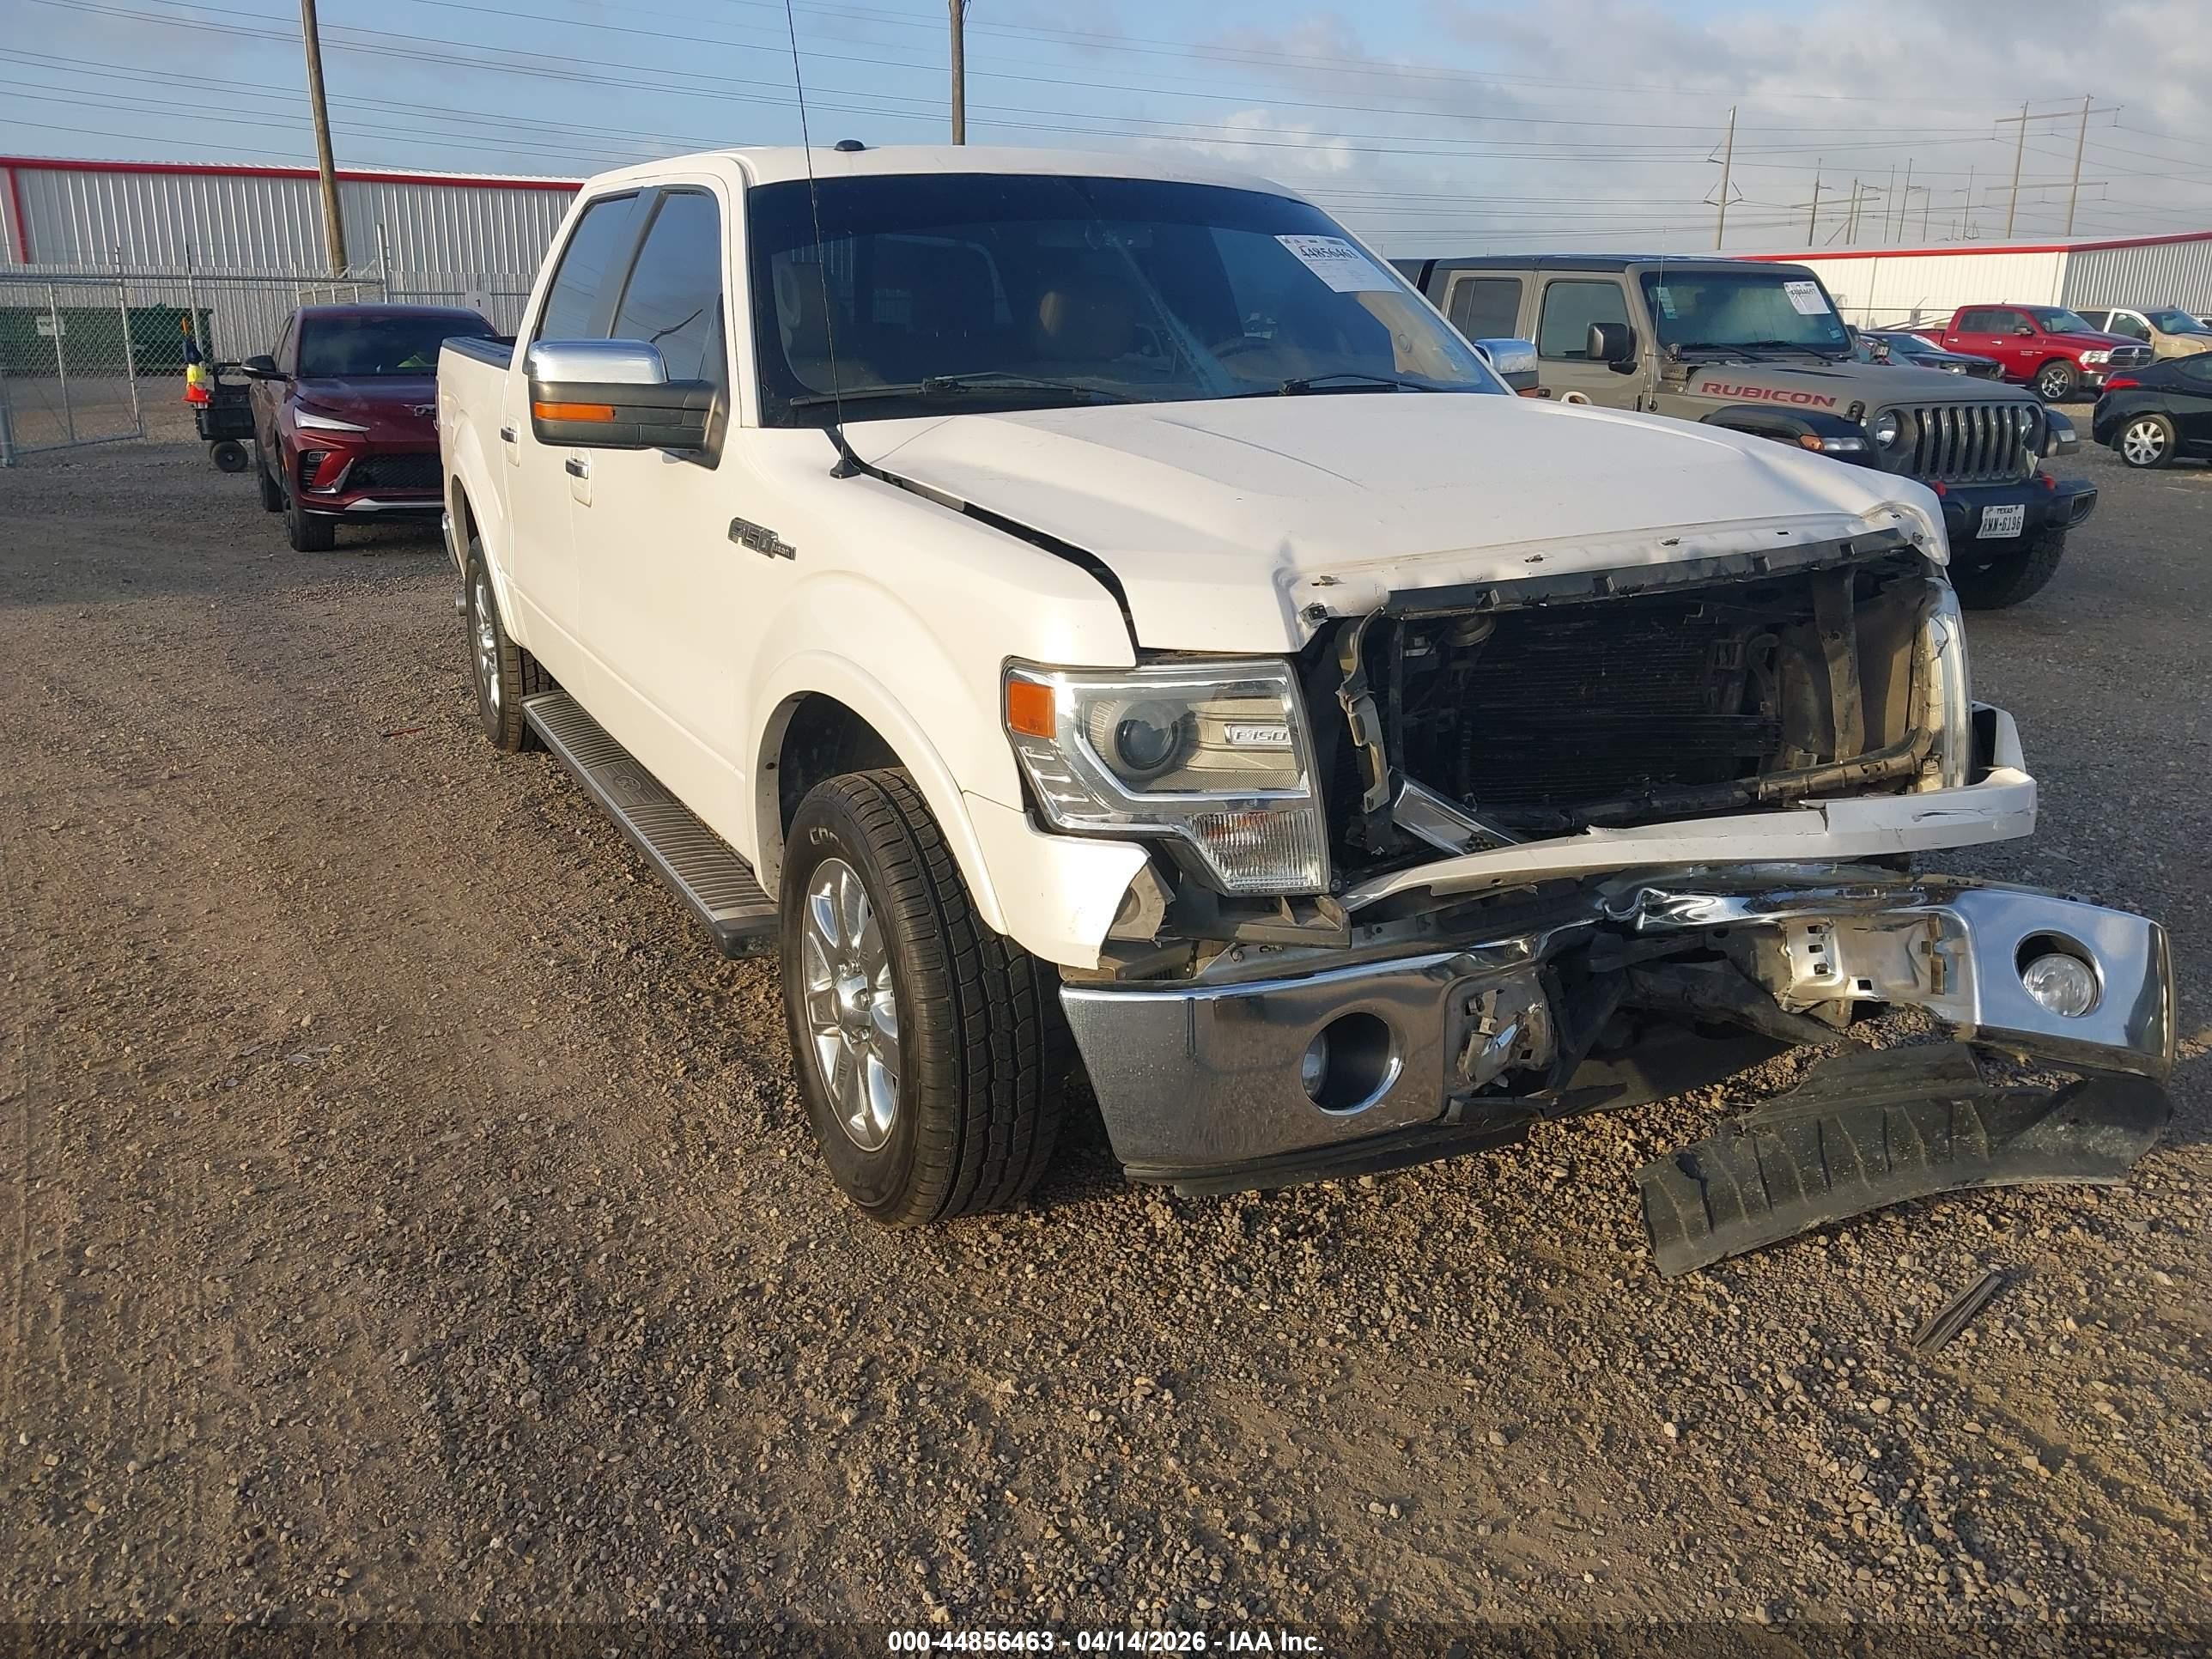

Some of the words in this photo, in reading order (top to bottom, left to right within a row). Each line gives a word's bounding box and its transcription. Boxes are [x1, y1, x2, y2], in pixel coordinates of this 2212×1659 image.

[1301, 246, 1360, 259] 44856463
[1701, 382, 1837, 408] RUBICON
[1236, 729, 1288, 741] F150
